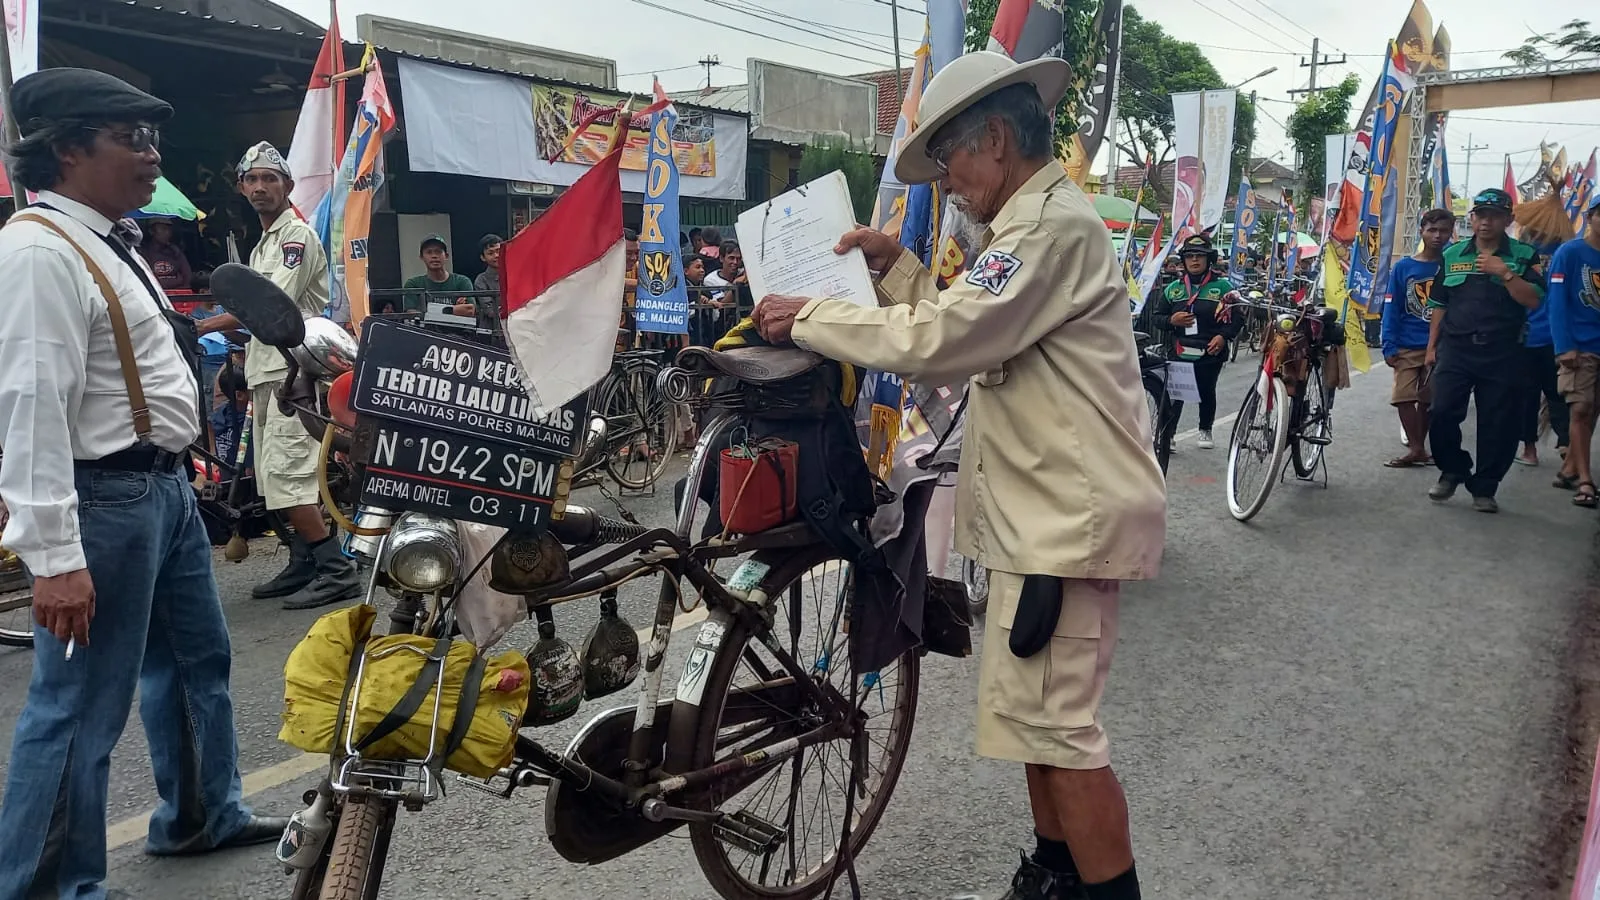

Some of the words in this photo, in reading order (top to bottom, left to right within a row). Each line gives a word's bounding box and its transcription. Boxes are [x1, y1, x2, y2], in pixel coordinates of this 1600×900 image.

[635, 299, 687, 313] ONDANGLEGI
[635, 312, 649, 322] AB.
[650, 313, 684, 325] MALANG
[422, 344, 474, 378] AYO
[477, 356, 526, 395] KER
[371, 392, 454, 421] SATLANTAS
[458, 410, 513, 434] POLRES
[516, 424, 570, 447] MALANG
[376, 366, 452, 402] TERTIB
[455, 383, 507, 414] LALU
[508, 395, 575, 432] LINAS
[374, 430, 398, 466] N
[417, 437, 492, 482] 1942
[499, 453, 555, 497] SPM
[366, 476, 409, 500] AREMA
[413, 483, 451, 507] ONTEL
[469, 495, 499, 516] 03
